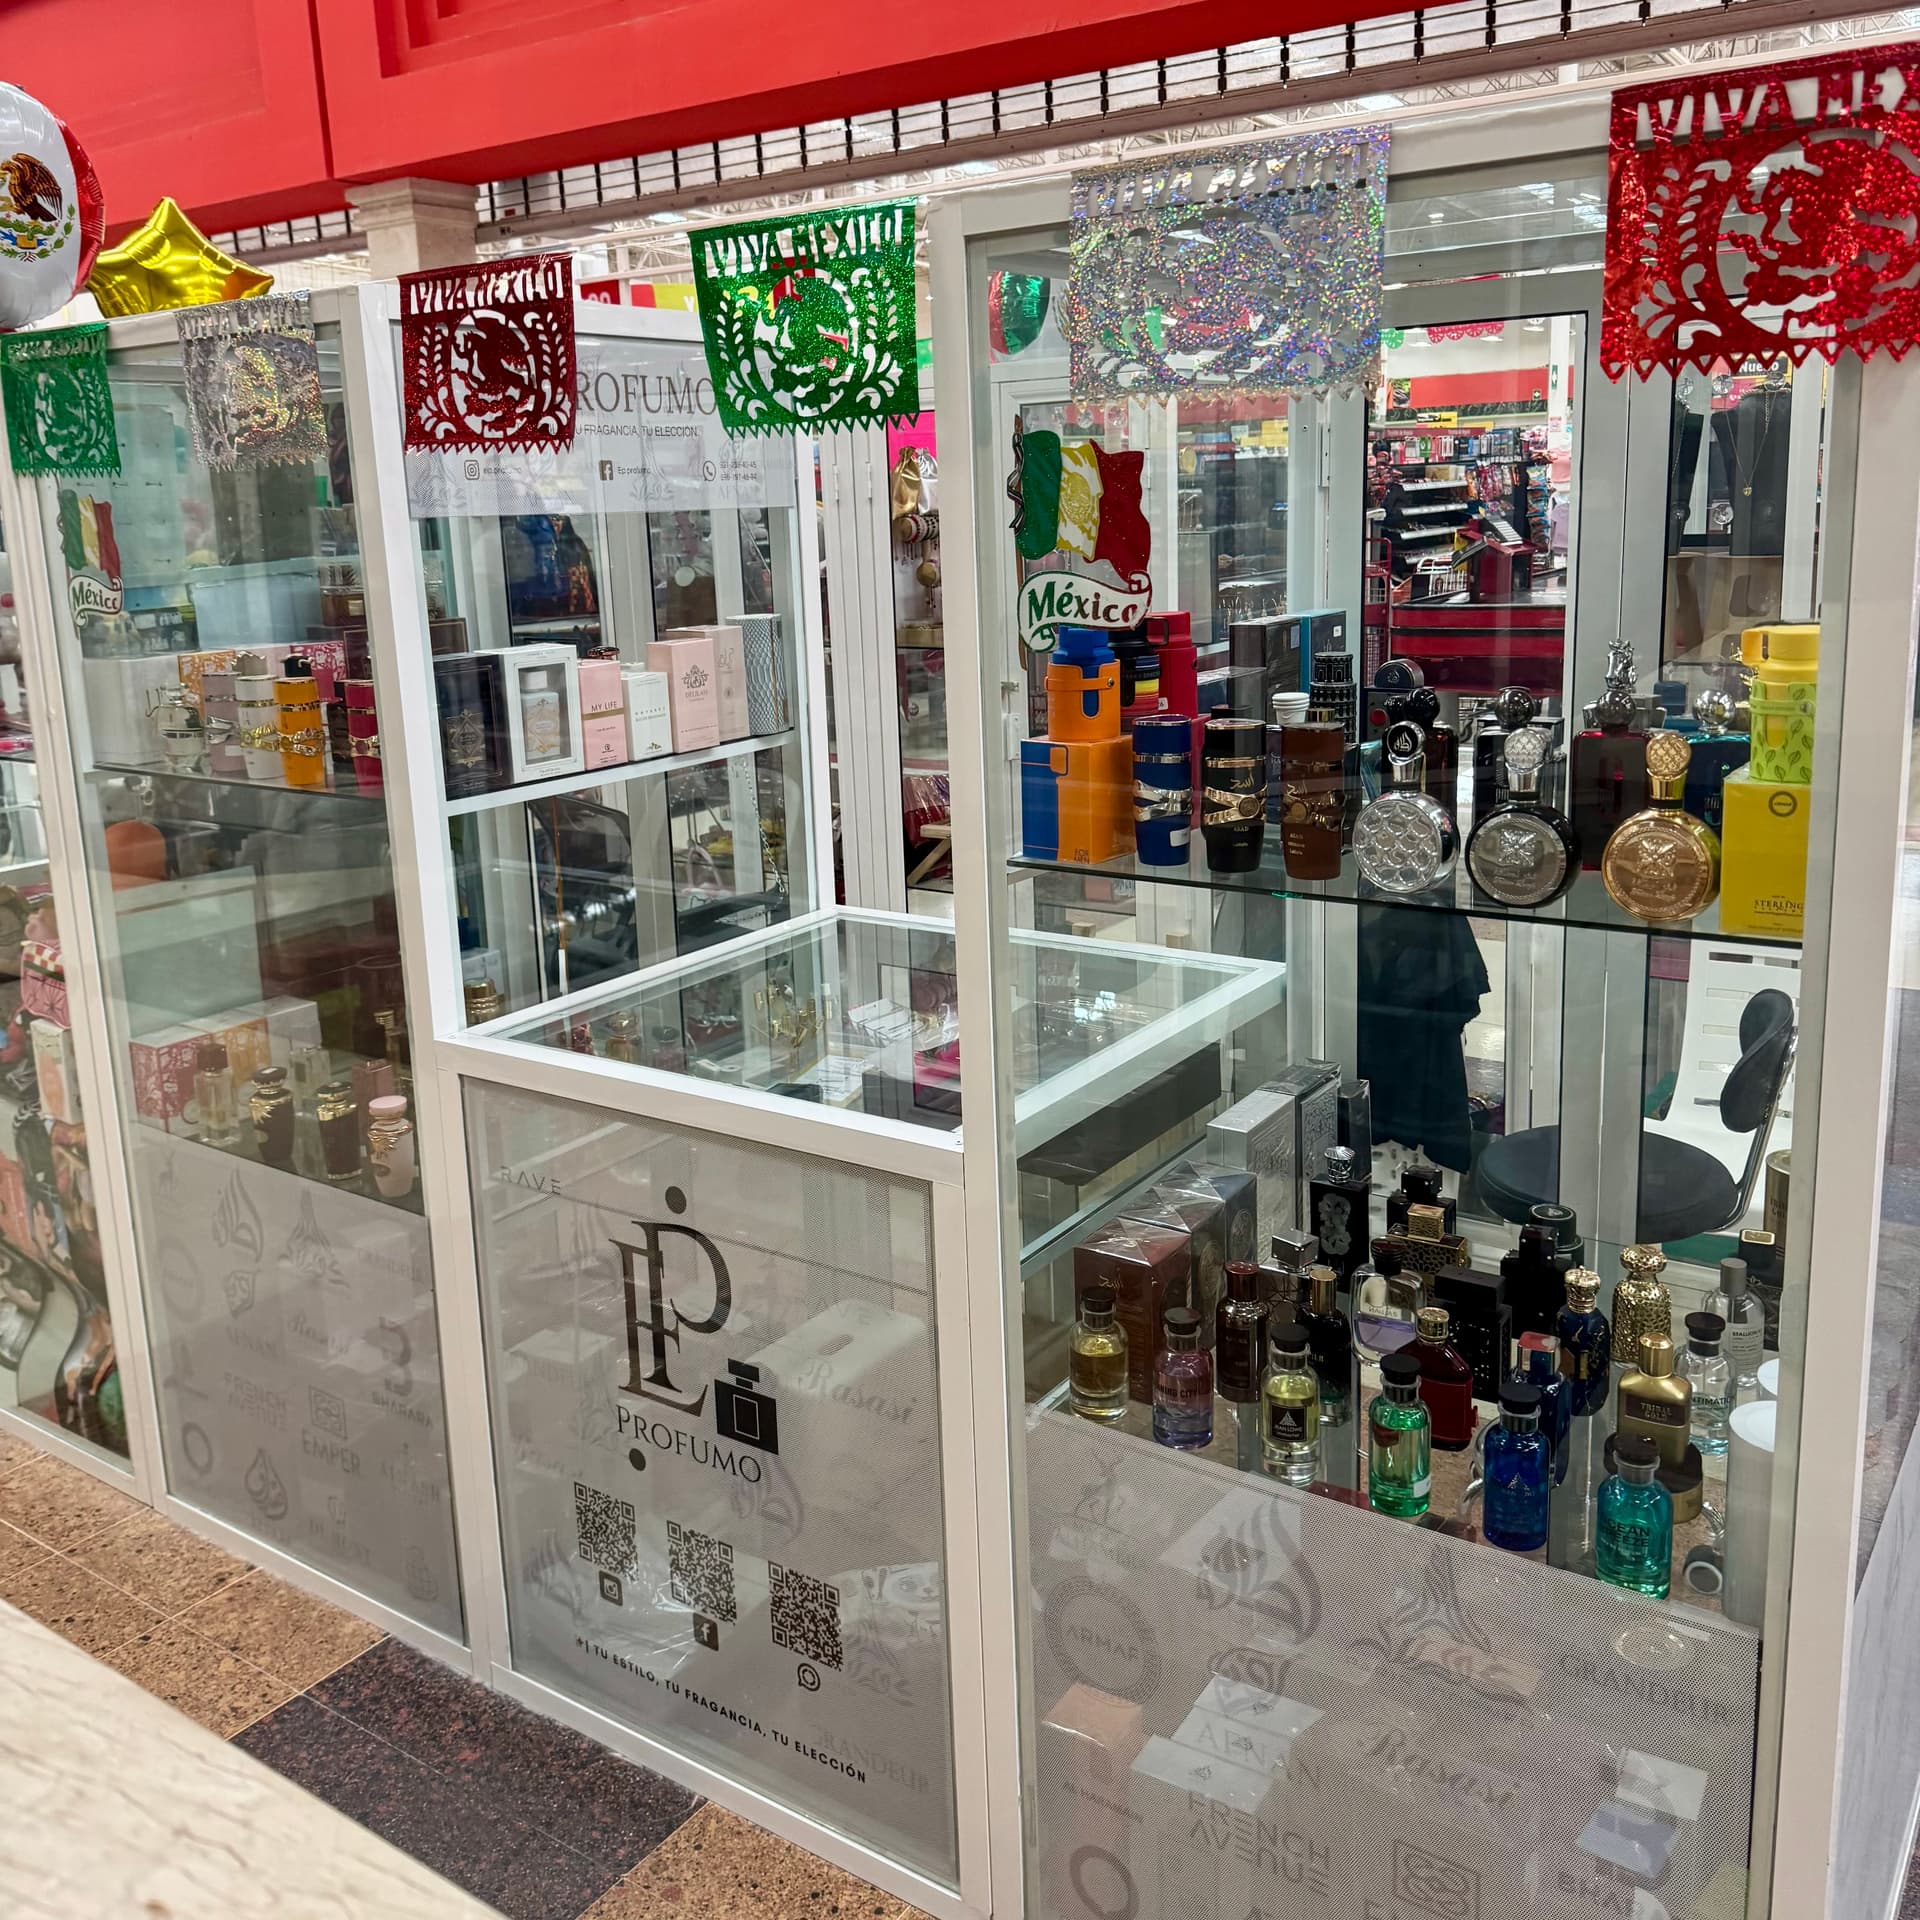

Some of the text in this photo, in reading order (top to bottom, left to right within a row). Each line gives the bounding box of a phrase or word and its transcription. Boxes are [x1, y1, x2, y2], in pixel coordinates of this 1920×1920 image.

[705, 208, 903, 278] VIVA MEXICO
[574, 371, 717, 416] ROFUMO
[1739, 360, 1780, 374] Nueo
[591, 701, 618, 713] MY LIFE
[500, 1165, 562, 1197] RAVE
[615, 1404, 762, 1484] PROFUMO
[595, 1645, 608, 1660] TU
[664, 1678, 680, 1695] TU
[684, 1687, 767, 1738] FRAGANCIA,
[772, 1728, 790, 1747] TU
[794, 1740, 867, 1784] ELECCIÓN
[1187, 1792, 1331, 1870] FRENCH
